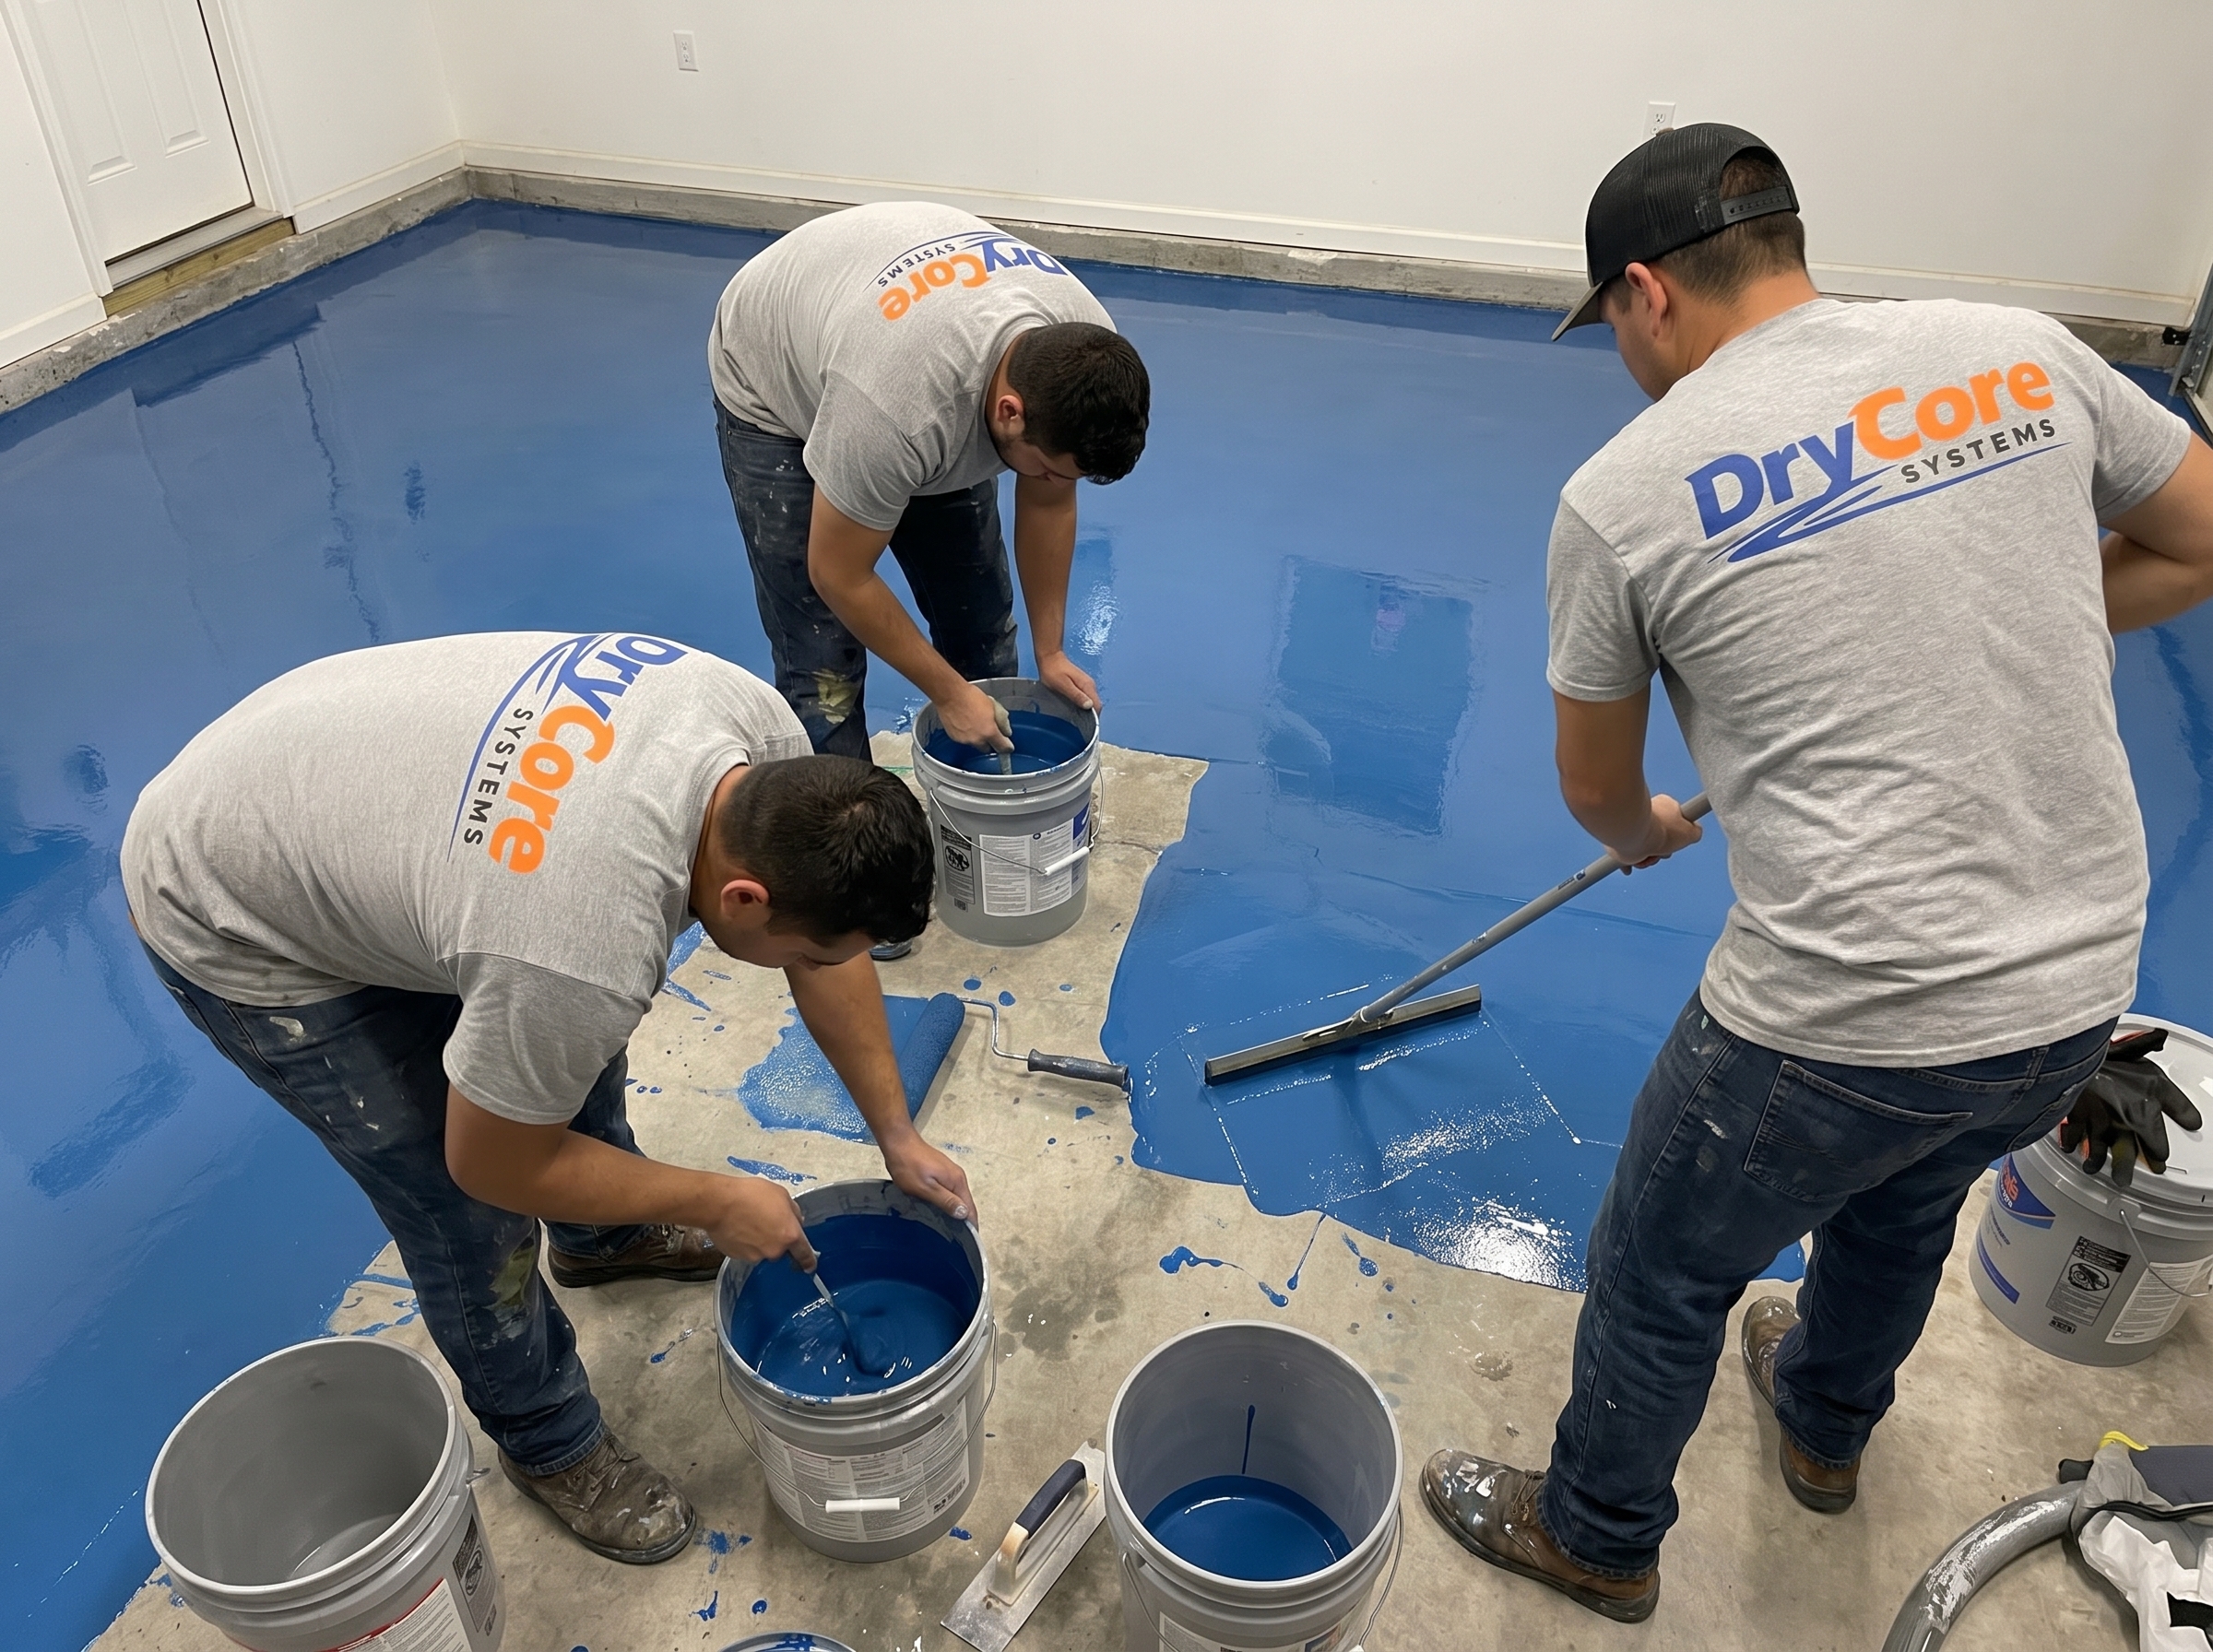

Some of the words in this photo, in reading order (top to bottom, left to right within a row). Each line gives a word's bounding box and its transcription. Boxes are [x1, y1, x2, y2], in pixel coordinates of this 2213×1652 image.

[878, 242, 956, 288] SYSTEMS
[879, 238, 1069, 321] DryCore
[1685, 361, 2055, 542] DryCore
[1900, 419, 2056, 484] SYSTEMS
[463, 707, 534, 845] SYSTEMS
[488, 635, 689, 875] DryCore
